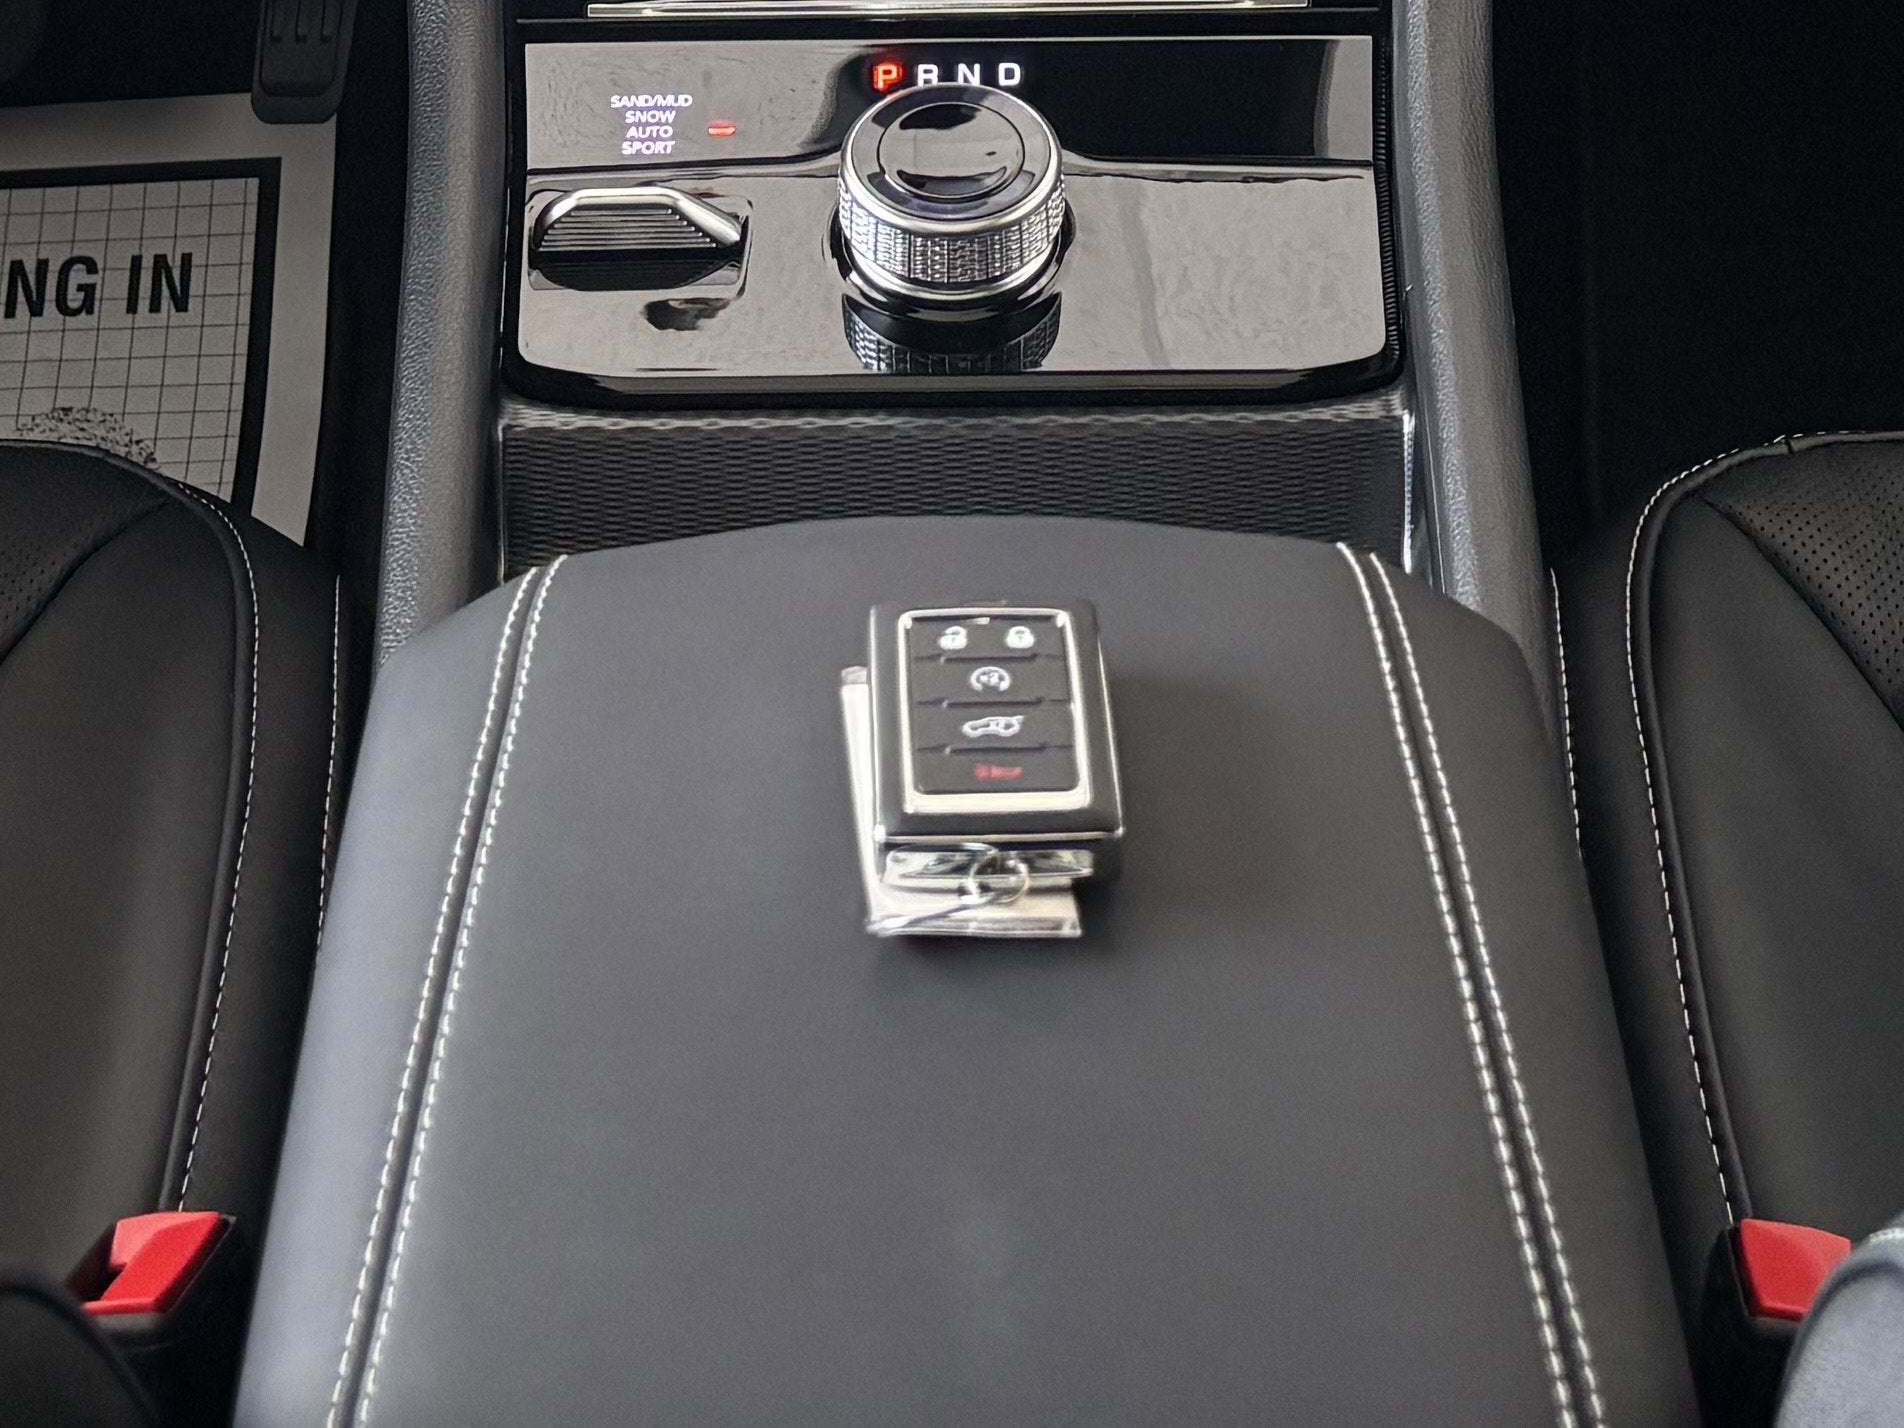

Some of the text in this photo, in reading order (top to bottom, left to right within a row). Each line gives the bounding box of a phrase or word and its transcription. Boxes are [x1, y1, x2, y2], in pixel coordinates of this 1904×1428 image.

[874, 62, 1021, 91] P R N D
[610, 94, 693, 108] SAND/MUD
[625, 110, 676, 123] SNOW
[626, 126, 673, 138] AUTO
[622, 140, 676, 155] SPORT
[124, 252, 194, 315] IN
